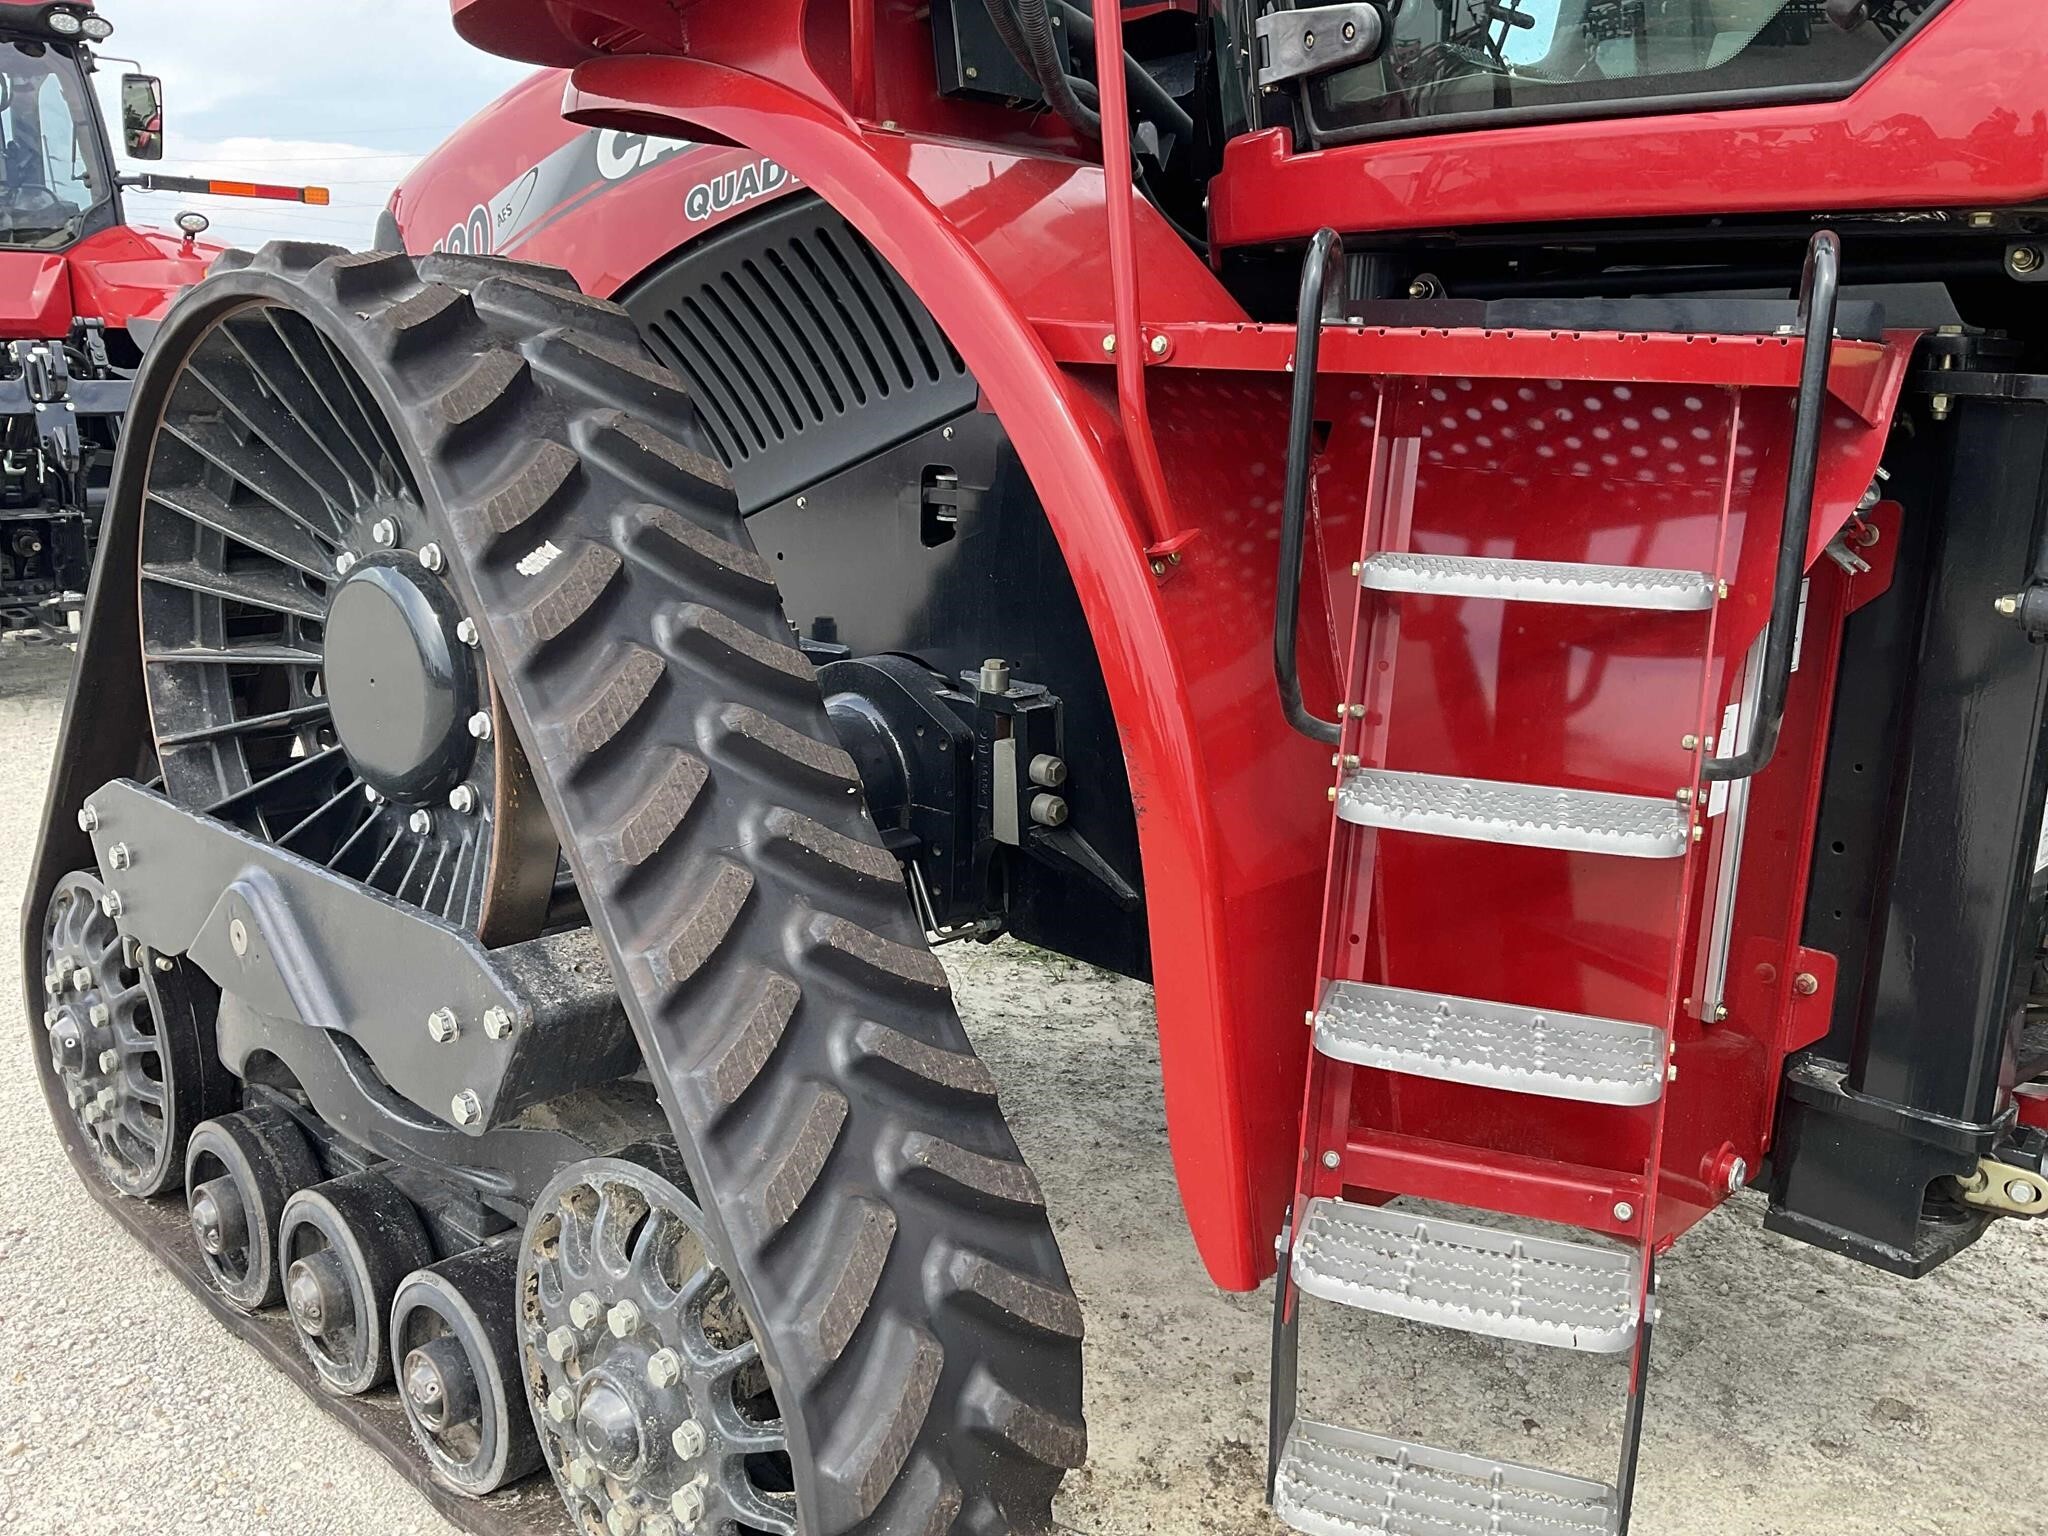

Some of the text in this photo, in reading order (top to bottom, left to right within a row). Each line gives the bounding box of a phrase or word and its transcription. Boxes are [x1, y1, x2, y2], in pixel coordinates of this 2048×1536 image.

[685, 158, 800, 221] QUAD
[433, 204, 490, 255] 00
[497, 203, 513, 228] AFS
